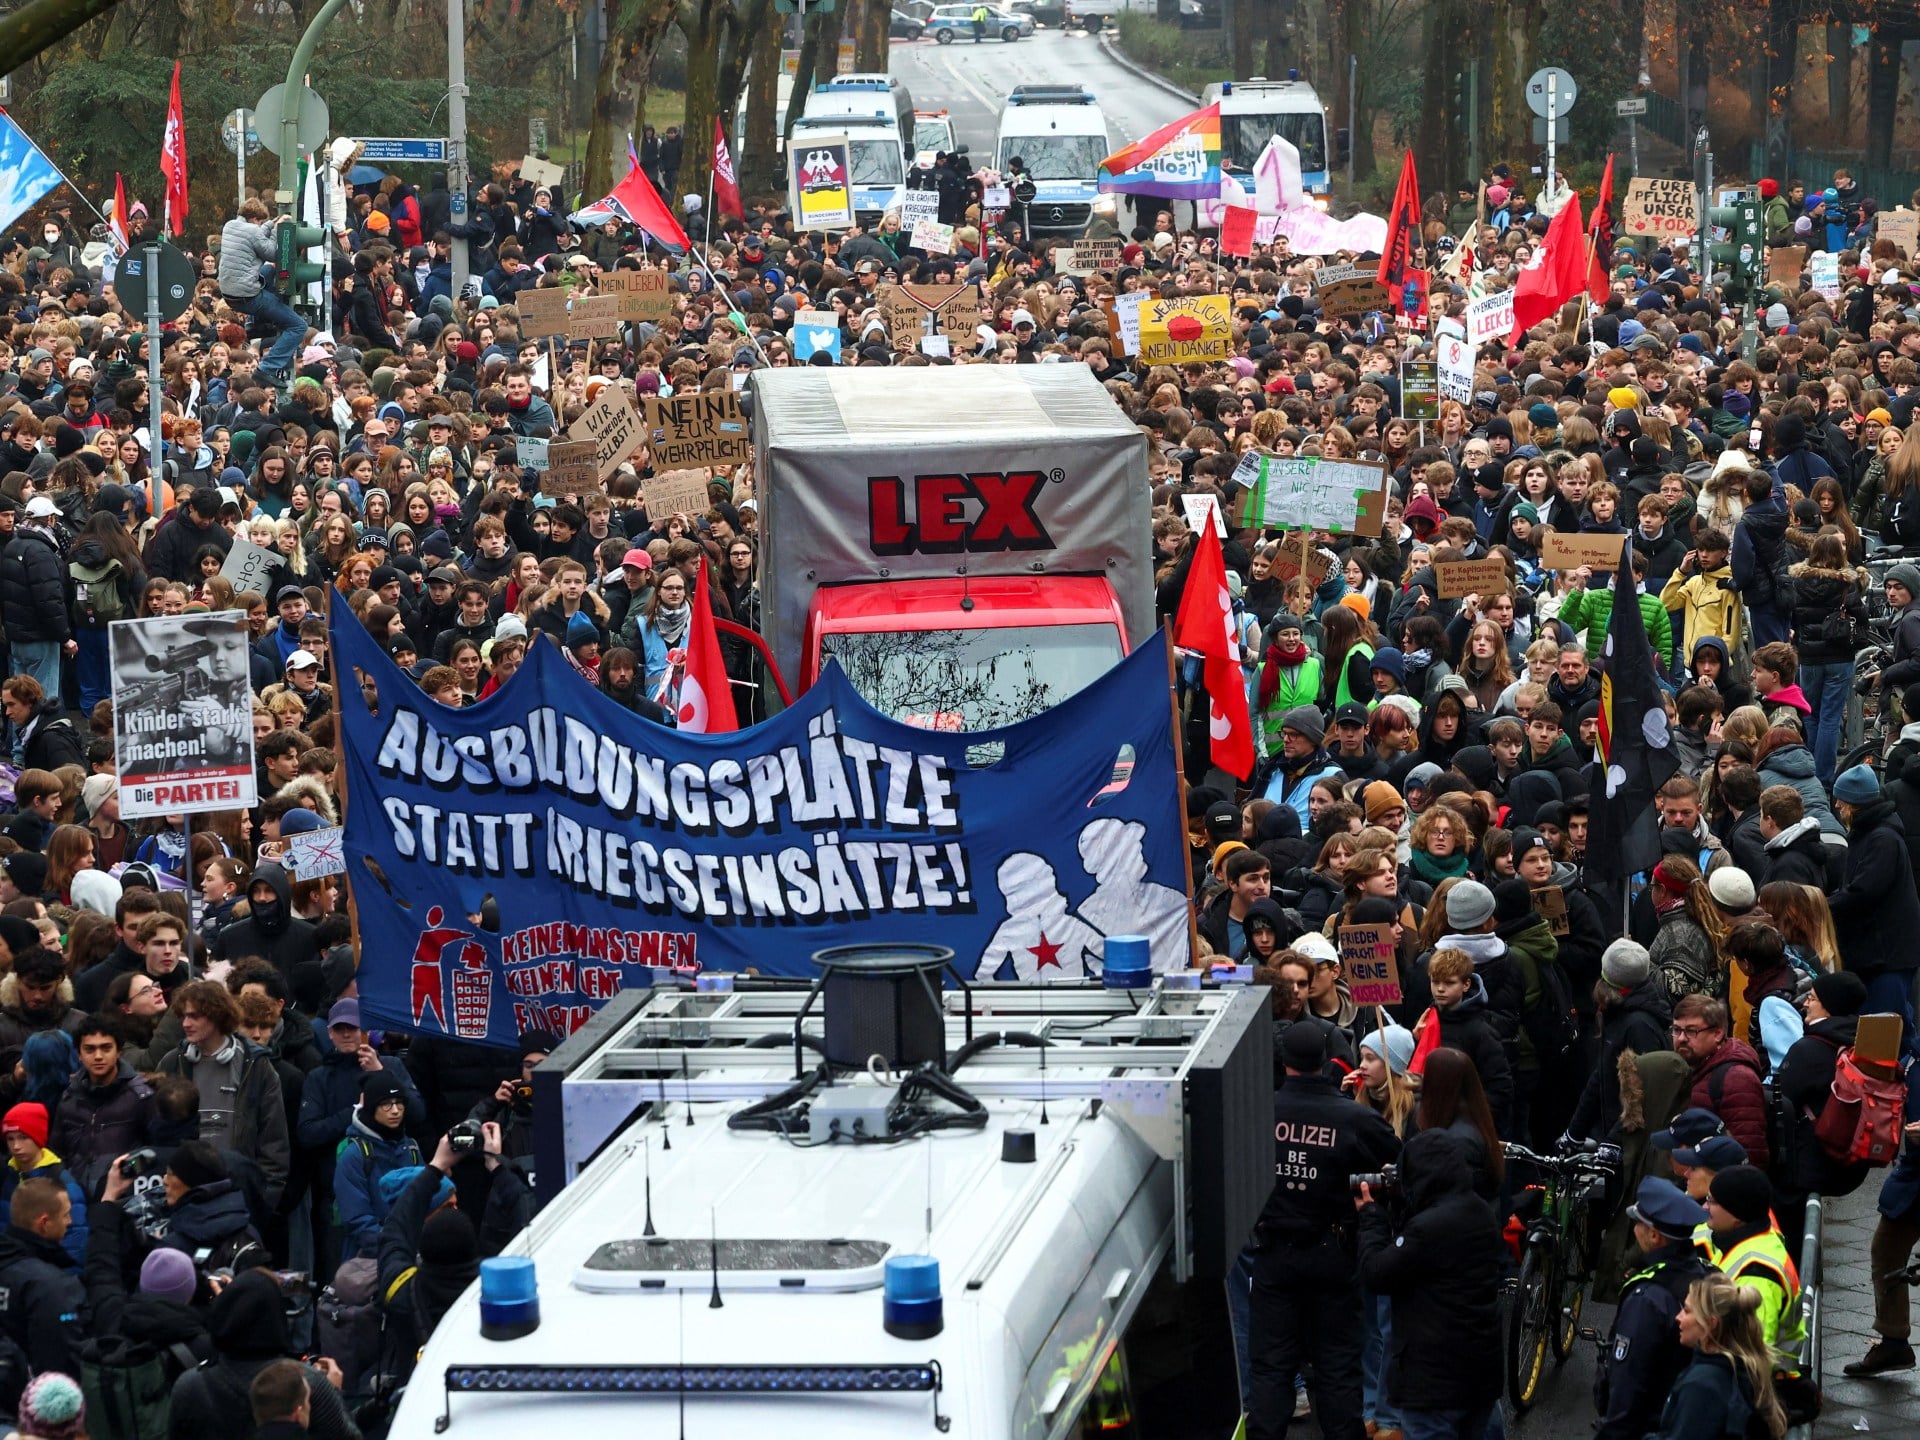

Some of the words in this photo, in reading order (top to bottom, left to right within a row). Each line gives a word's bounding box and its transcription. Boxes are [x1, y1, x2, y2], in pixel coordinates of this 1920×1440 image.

[1650, 180, 1691, 193] EURE
[1644, 204, 1695, 220] UNSER
[1652, 216, 1687, 231] TOD
[1076, 250, 1097, 259] NICHT
[1076, 259, 1100, 268] EUREN
[601, 279, 624, 292] MEIN
[628, 274, 664, 291] LEBEN
[894, 304, 918, 315] Same
[894, 317, 918, 331] Shit
[947, 316, 973, 338] Day
[1148, 344, 1177, 359] NEIN
[1181, 340, 1229, 357] DANKE!
[586, 403, 612, 433] WIR
[657, 394, 736, 425] NEIN!
[672, 419, 717, 439] ZUR
[596, 417, 636, 468] SELBST!
[653, 438, 748, 464] WEHRPFLICHT
[1268, 462, 1310, 476] UNSERE
[1291, 481, 1333, 498] NICHT
[647, 492, 705, 519] WEHRPFLICHT
[867, 470, 1057, 557] LEX
[124, 709, 186, 734] Kinder
[192, 703, 240, 726] stark
[125, 733, 206, 762] machen!
[376, 706, 959, 832] AUSBILDUNGSPLÄTZE
[135, 788, 153, 802] Die
[382, 795, 534, 874] STATT
[297, 865, 324, 879] NEIN
[1341, 930, 1379, 945] FRIEDEN
[1350, 963, 1388, 979] KEINE
[1350, 981, 1400, 1002] MUSTERUNG
[1288, 1150, 1308, 1165] BE
[1275, 1163, 1318, 1180] 13310
